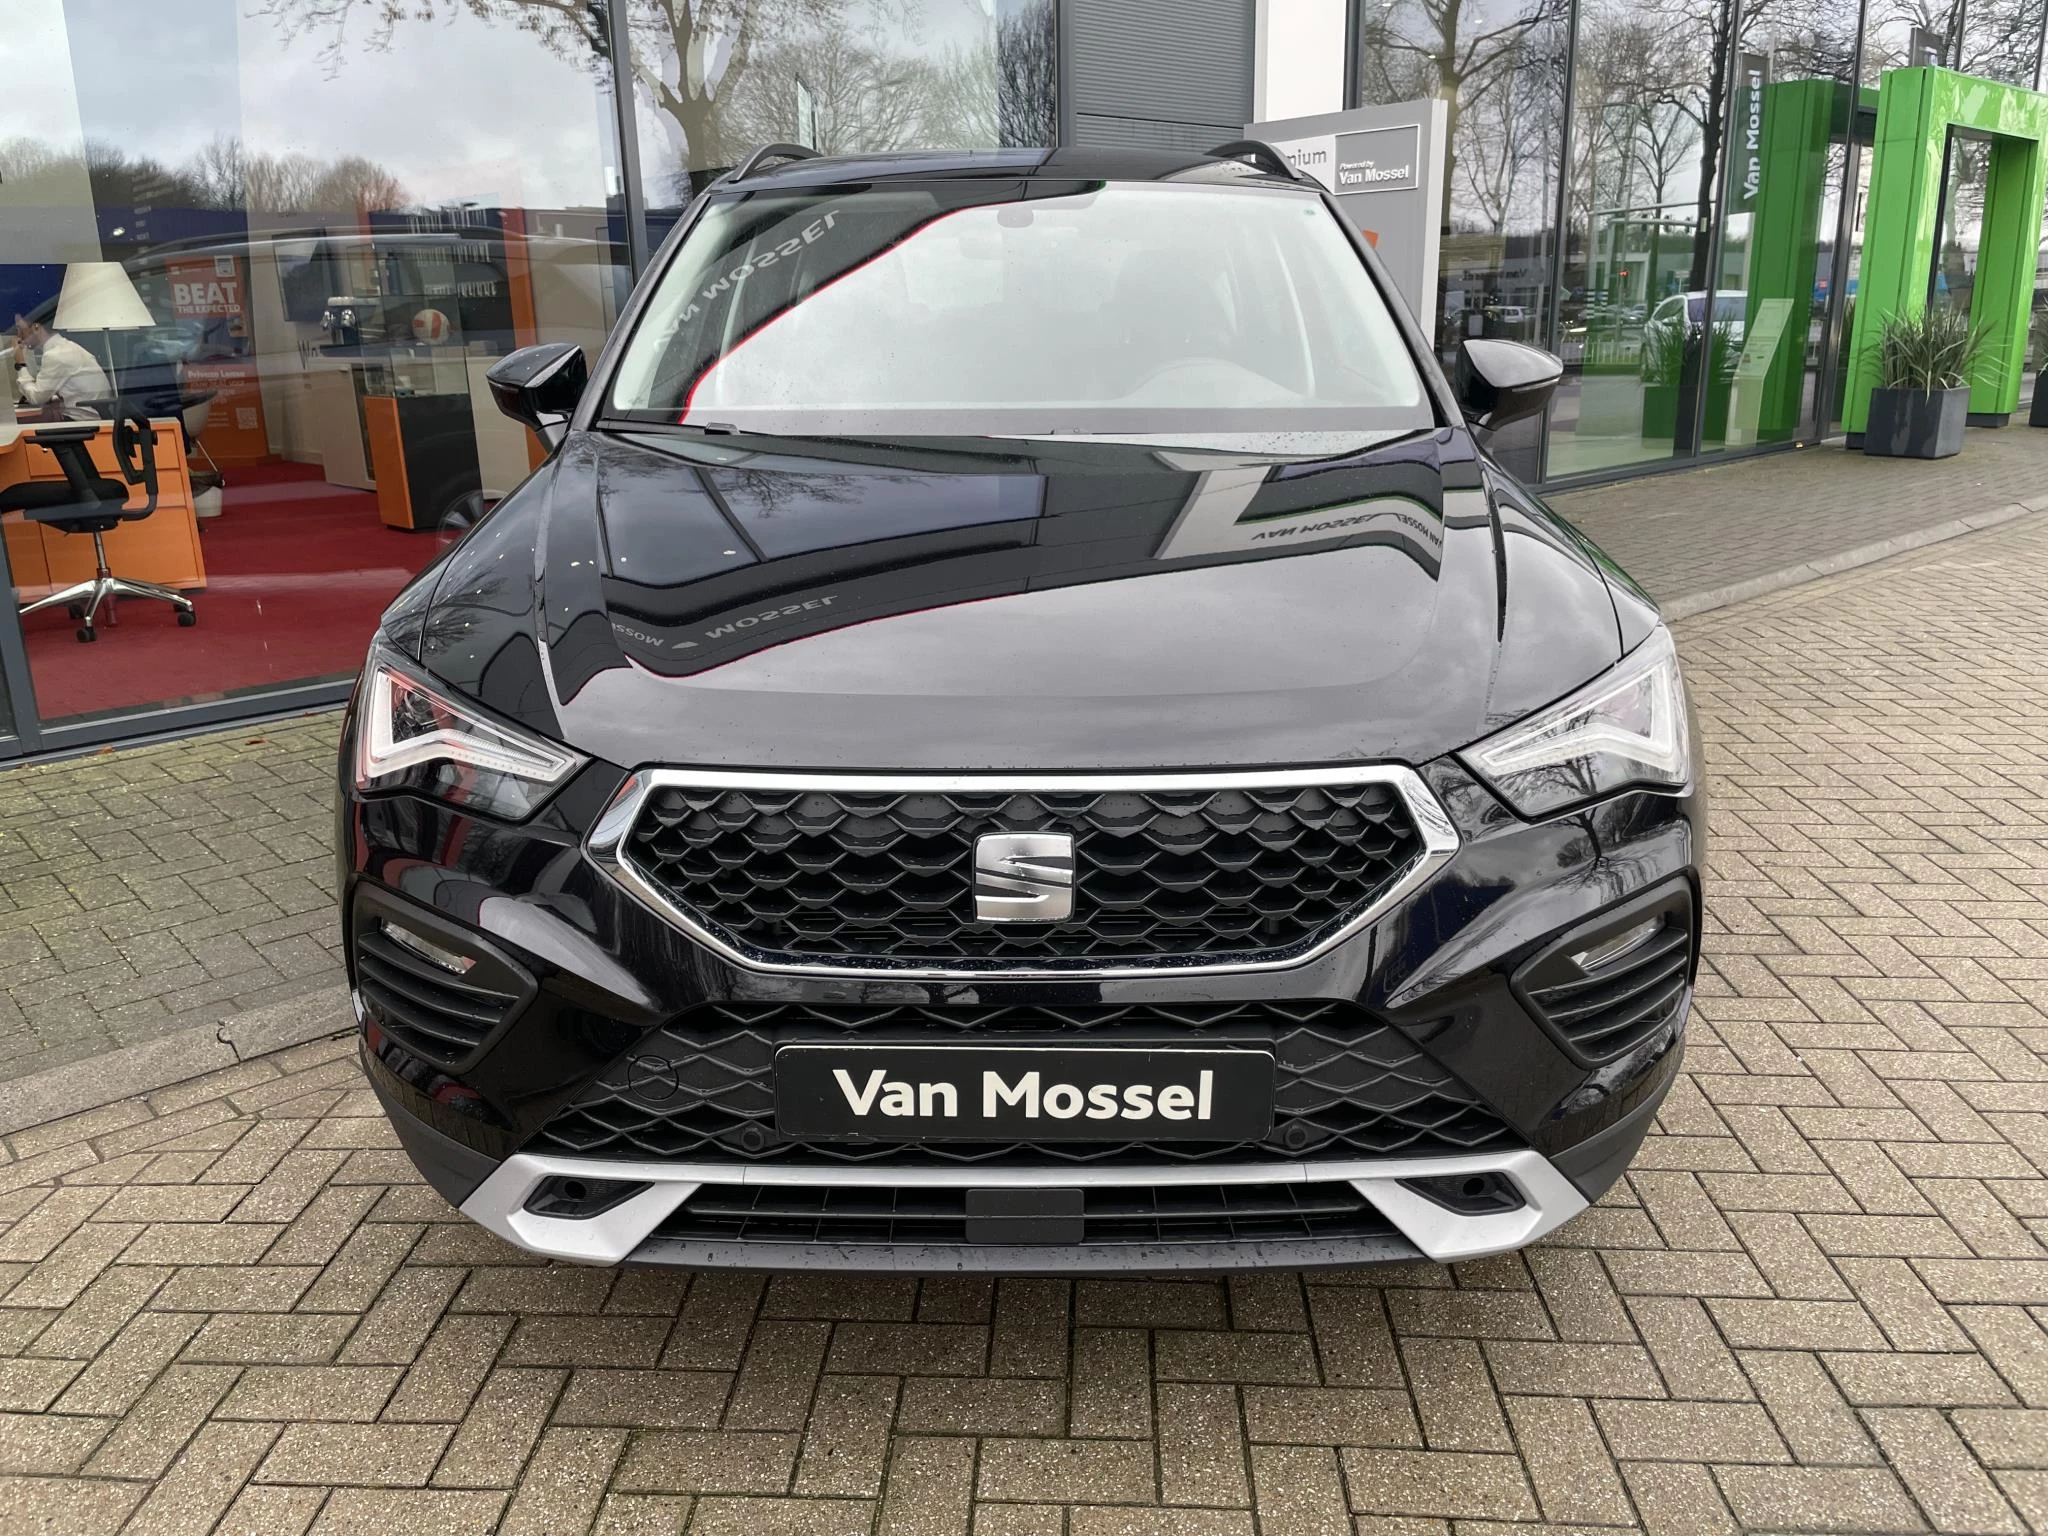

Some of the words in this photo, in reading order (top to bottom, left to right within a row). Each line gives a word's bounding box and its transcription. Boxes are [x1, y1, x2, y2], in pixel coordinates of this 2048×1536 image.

[1746, 69, 1761, 150] Mossel
[1339, 171, 1363, 185] Van
[1364, 165, 1409, 182] Mossel
[1743, 156, 1761, 200] Van
[173, 282, 238, 306] BEAT
[832, 1069, 958, 1117] Van
[982, 1070, 1213, 1120] Mossel
